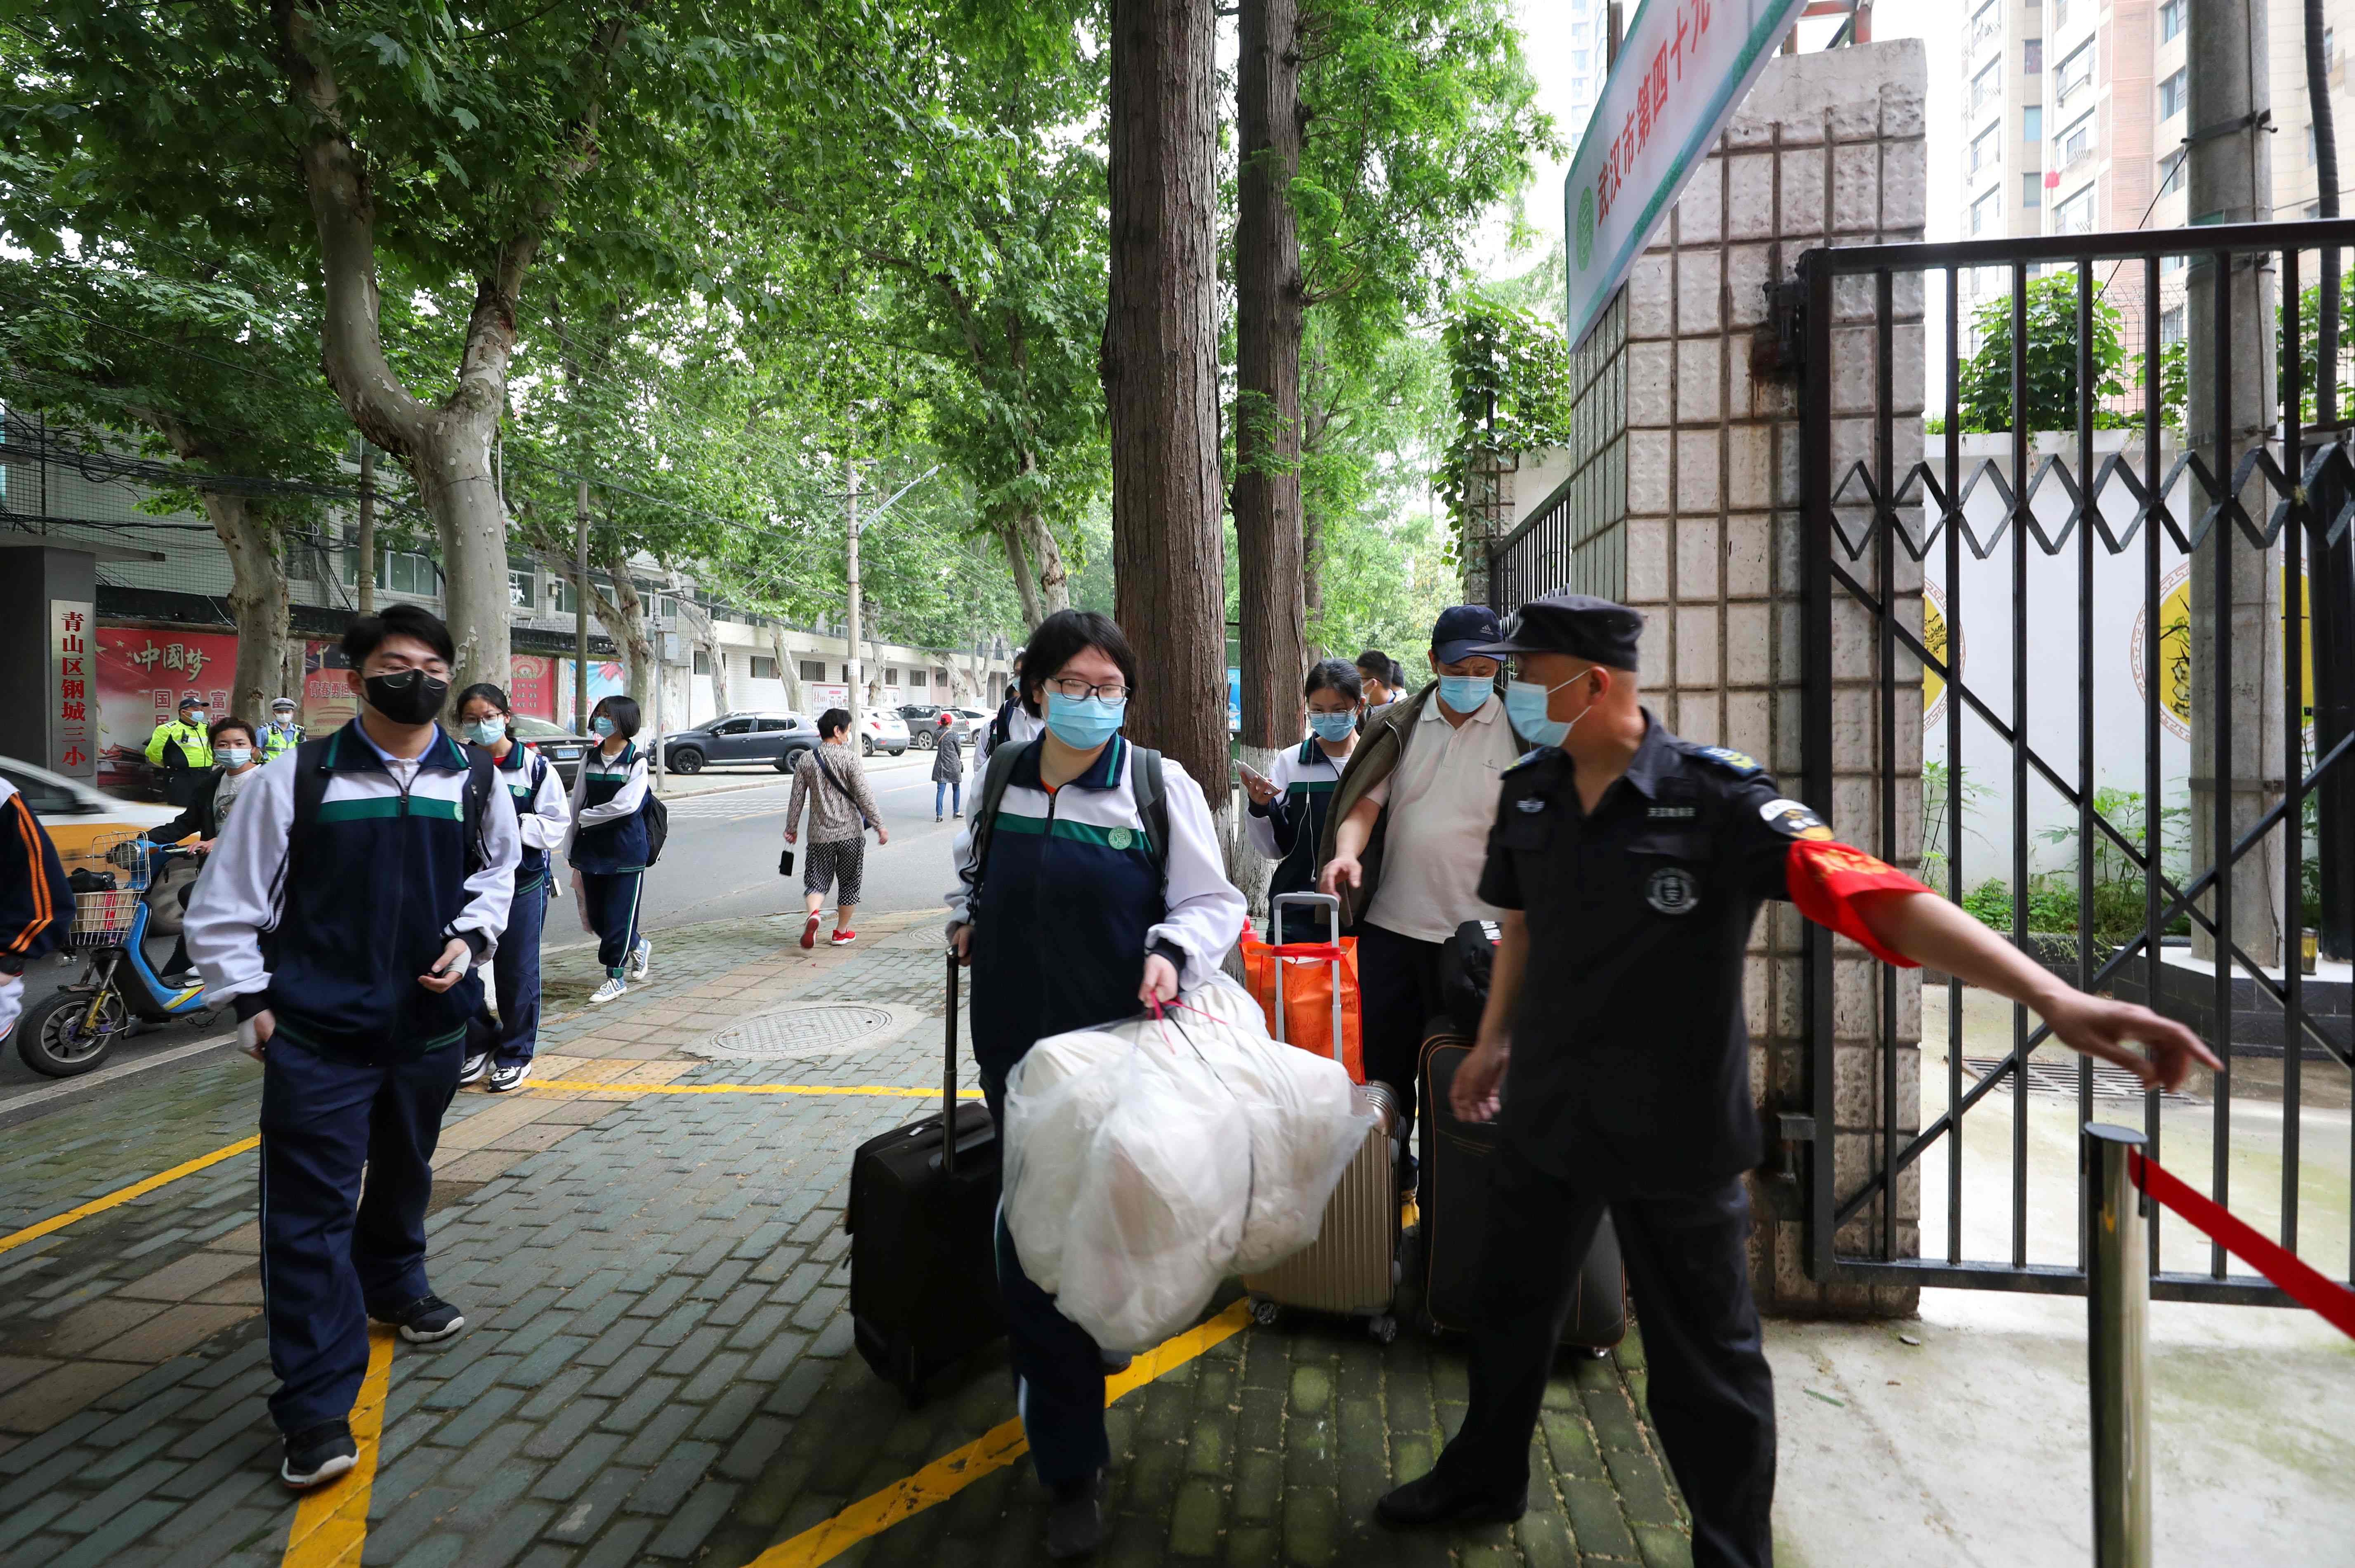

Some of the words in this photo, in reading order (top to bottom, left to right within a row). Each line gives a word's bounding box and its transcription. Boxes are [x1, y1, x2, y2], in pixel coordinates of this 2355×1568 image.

[61, 612, 86, 766] 青山区钢城三小
[309, 680, 357, 698] 青春勇担
